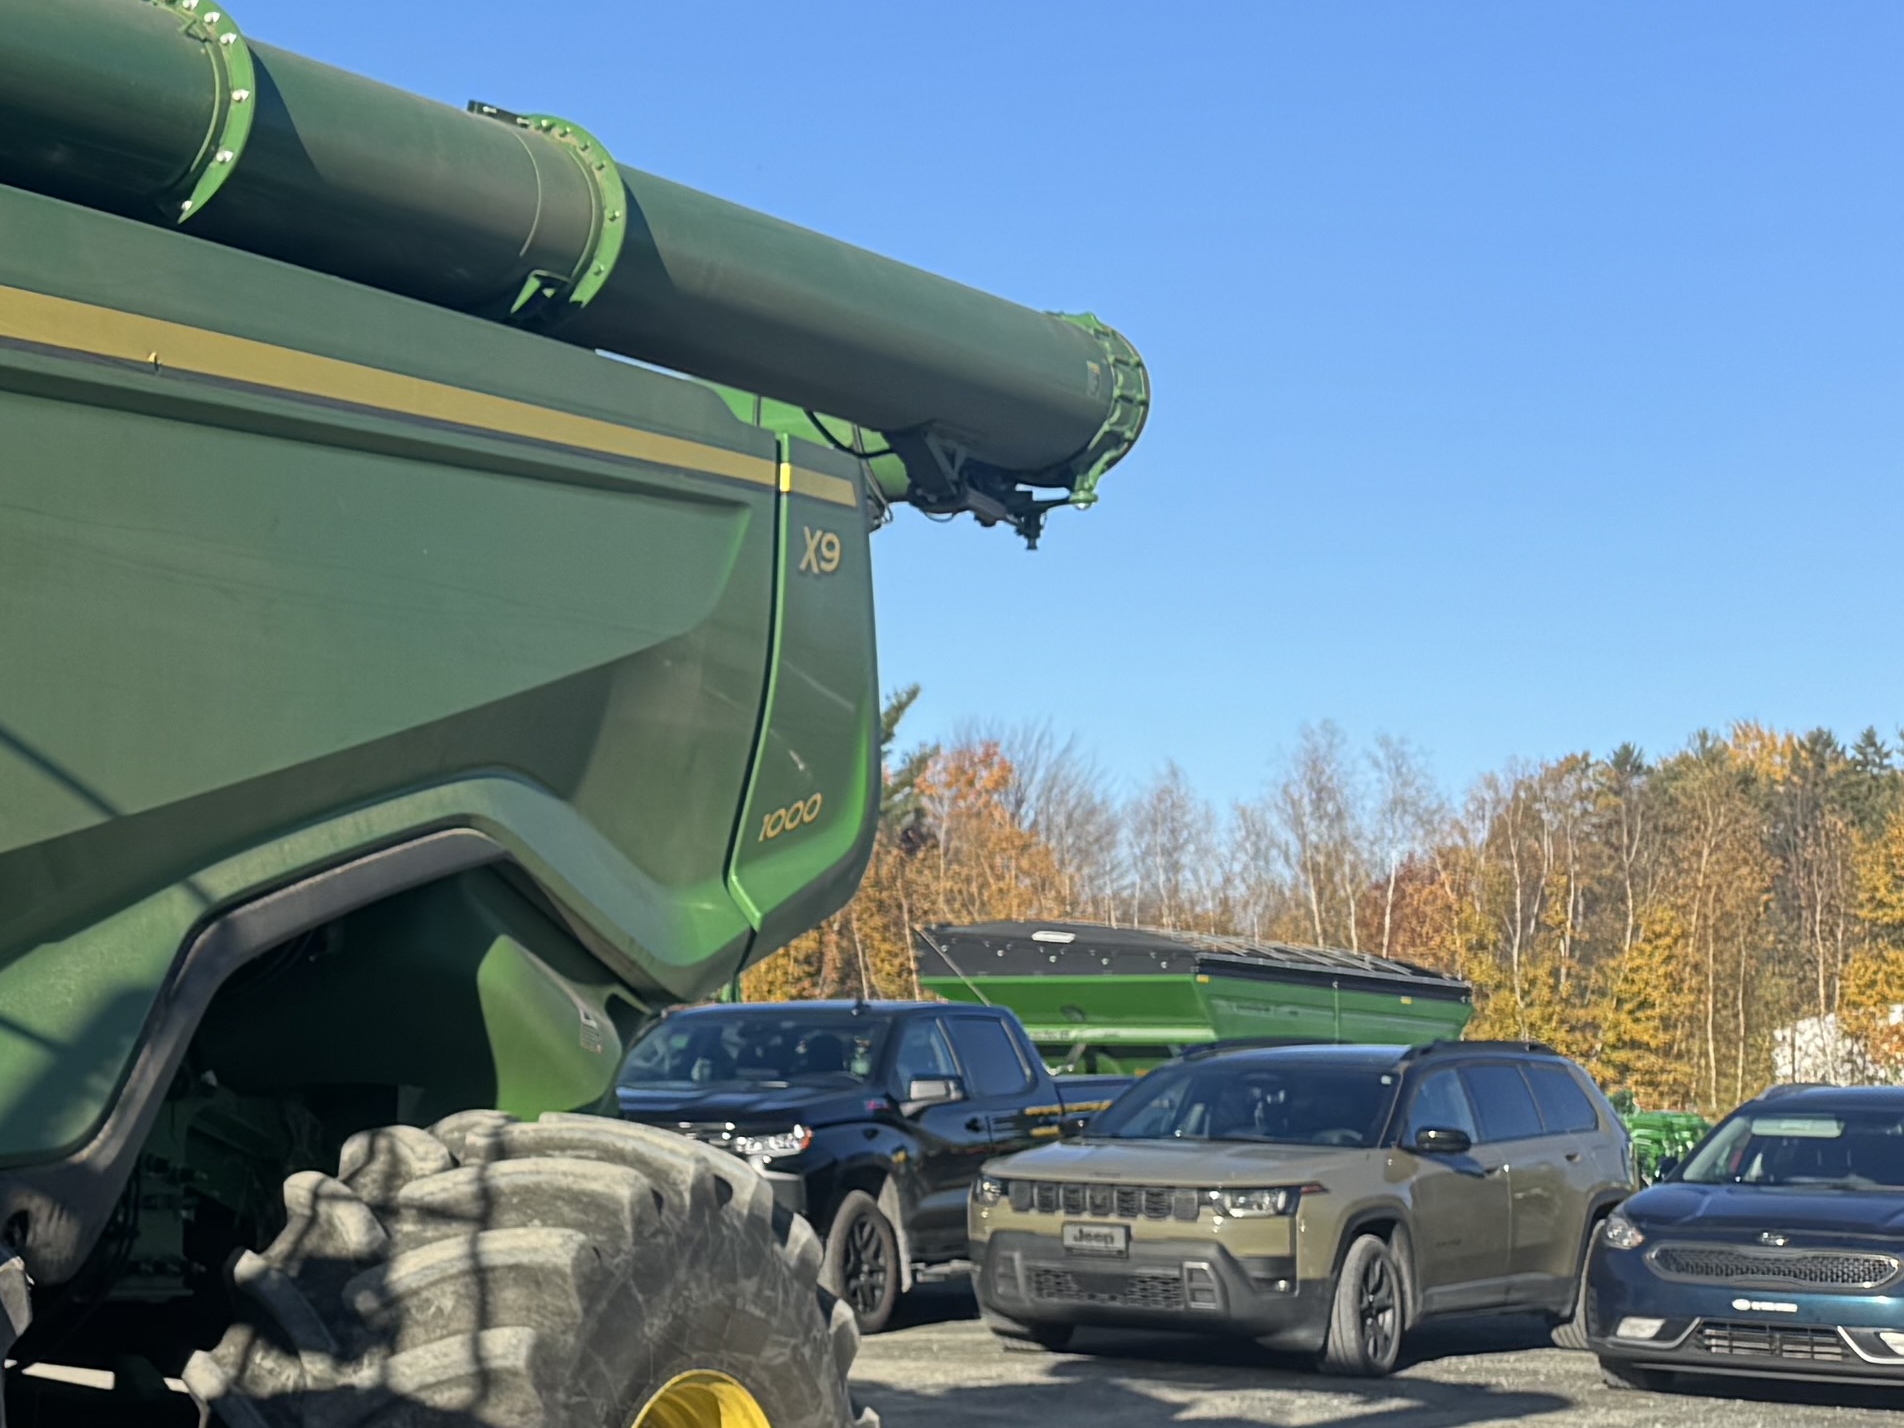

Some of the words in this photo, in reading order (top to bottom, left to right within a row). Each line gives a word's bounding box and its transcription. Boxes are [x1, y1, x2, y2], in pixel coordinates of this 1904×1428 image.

[798, 526, 842, 573] X9
[758, 791, 823, 842] 1000
[1072, 1228, 1115, 1246] Jeep
